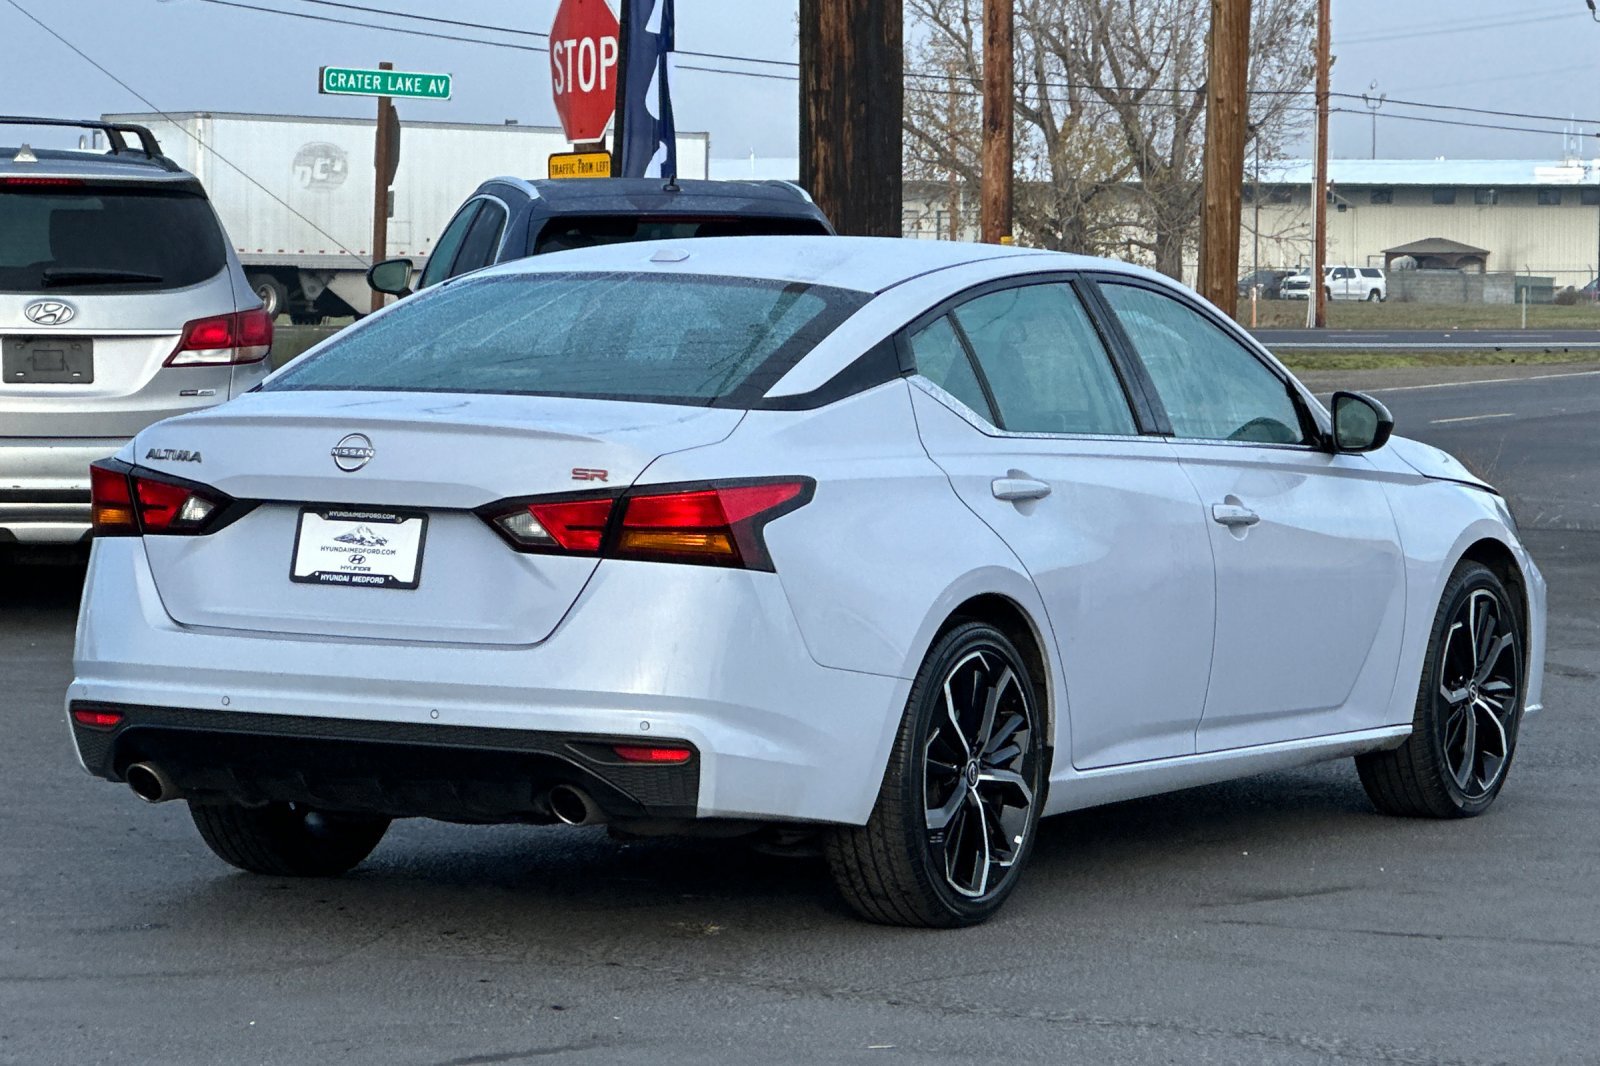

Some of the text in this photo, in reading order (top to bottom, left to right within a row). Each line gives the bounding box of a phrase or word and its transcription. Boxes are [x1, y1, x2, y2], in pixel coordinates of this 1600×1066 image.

[553, 35, 619, 95] STOP
[328, 72, 446, 94] CRATER LAKE AV
[551, 160, 609, 176] TRAFFIC FROM LEFT
[145, 448, 202, 463] ALTIMA
[331, 448, 375, 457] NISSAN
[571, 467, 609, 482] SR
[320, 545, 396, 555] HYUNDAIMEDFORD.COM
[320, 573, 385, 584] HYUNDAI MEDFORD
